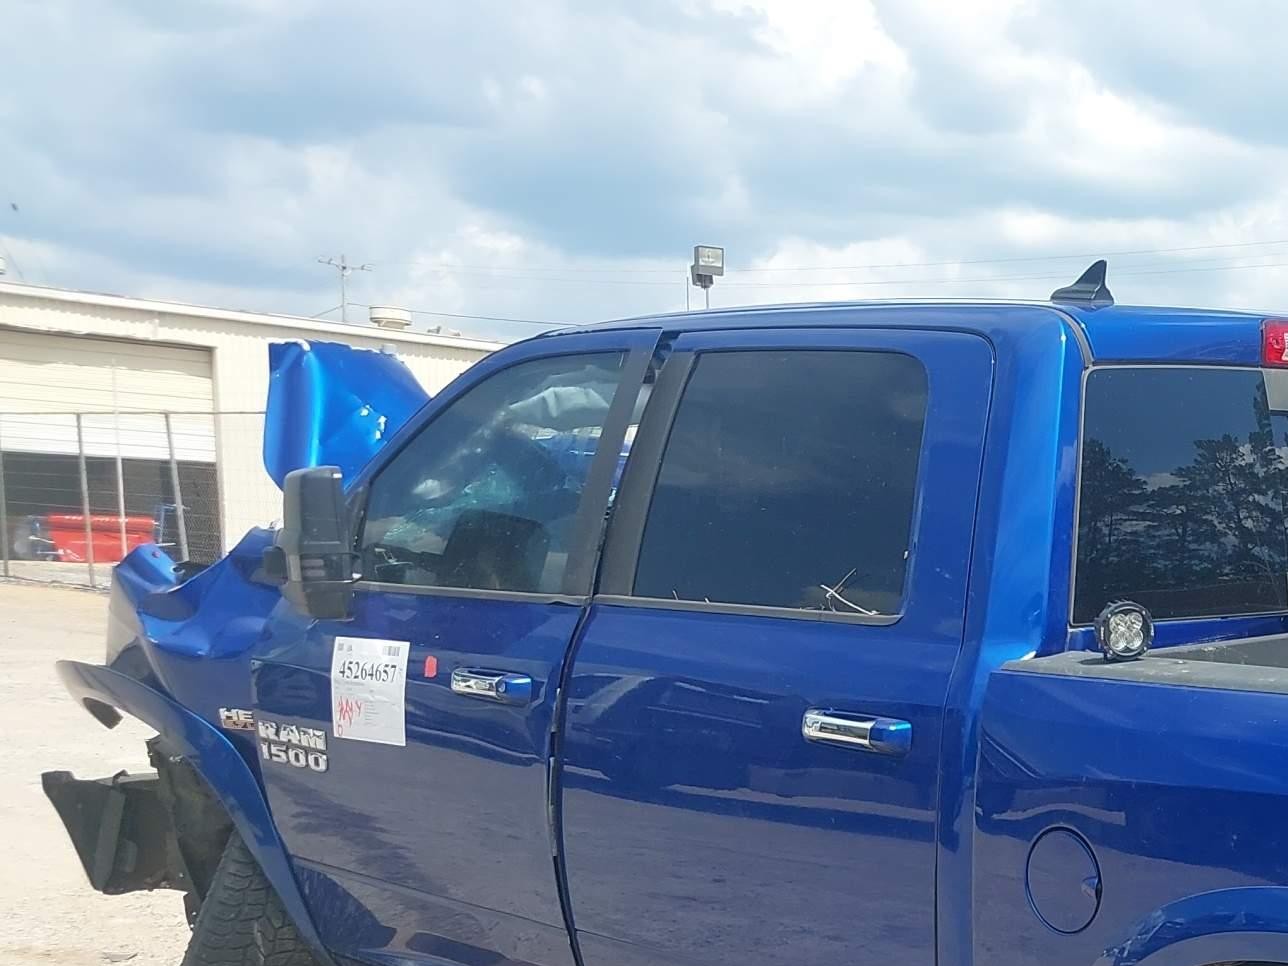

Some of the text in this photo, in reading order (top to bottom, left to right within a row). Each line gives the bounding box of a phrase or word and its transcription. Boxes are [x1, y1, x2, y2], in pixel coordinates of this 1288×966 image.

[339, 660, 397, 684] 45264657
[219, 708, 254, 721] HE
[258, 721, 327, 751] RAM
[260, 742, 328, 773] 1500
